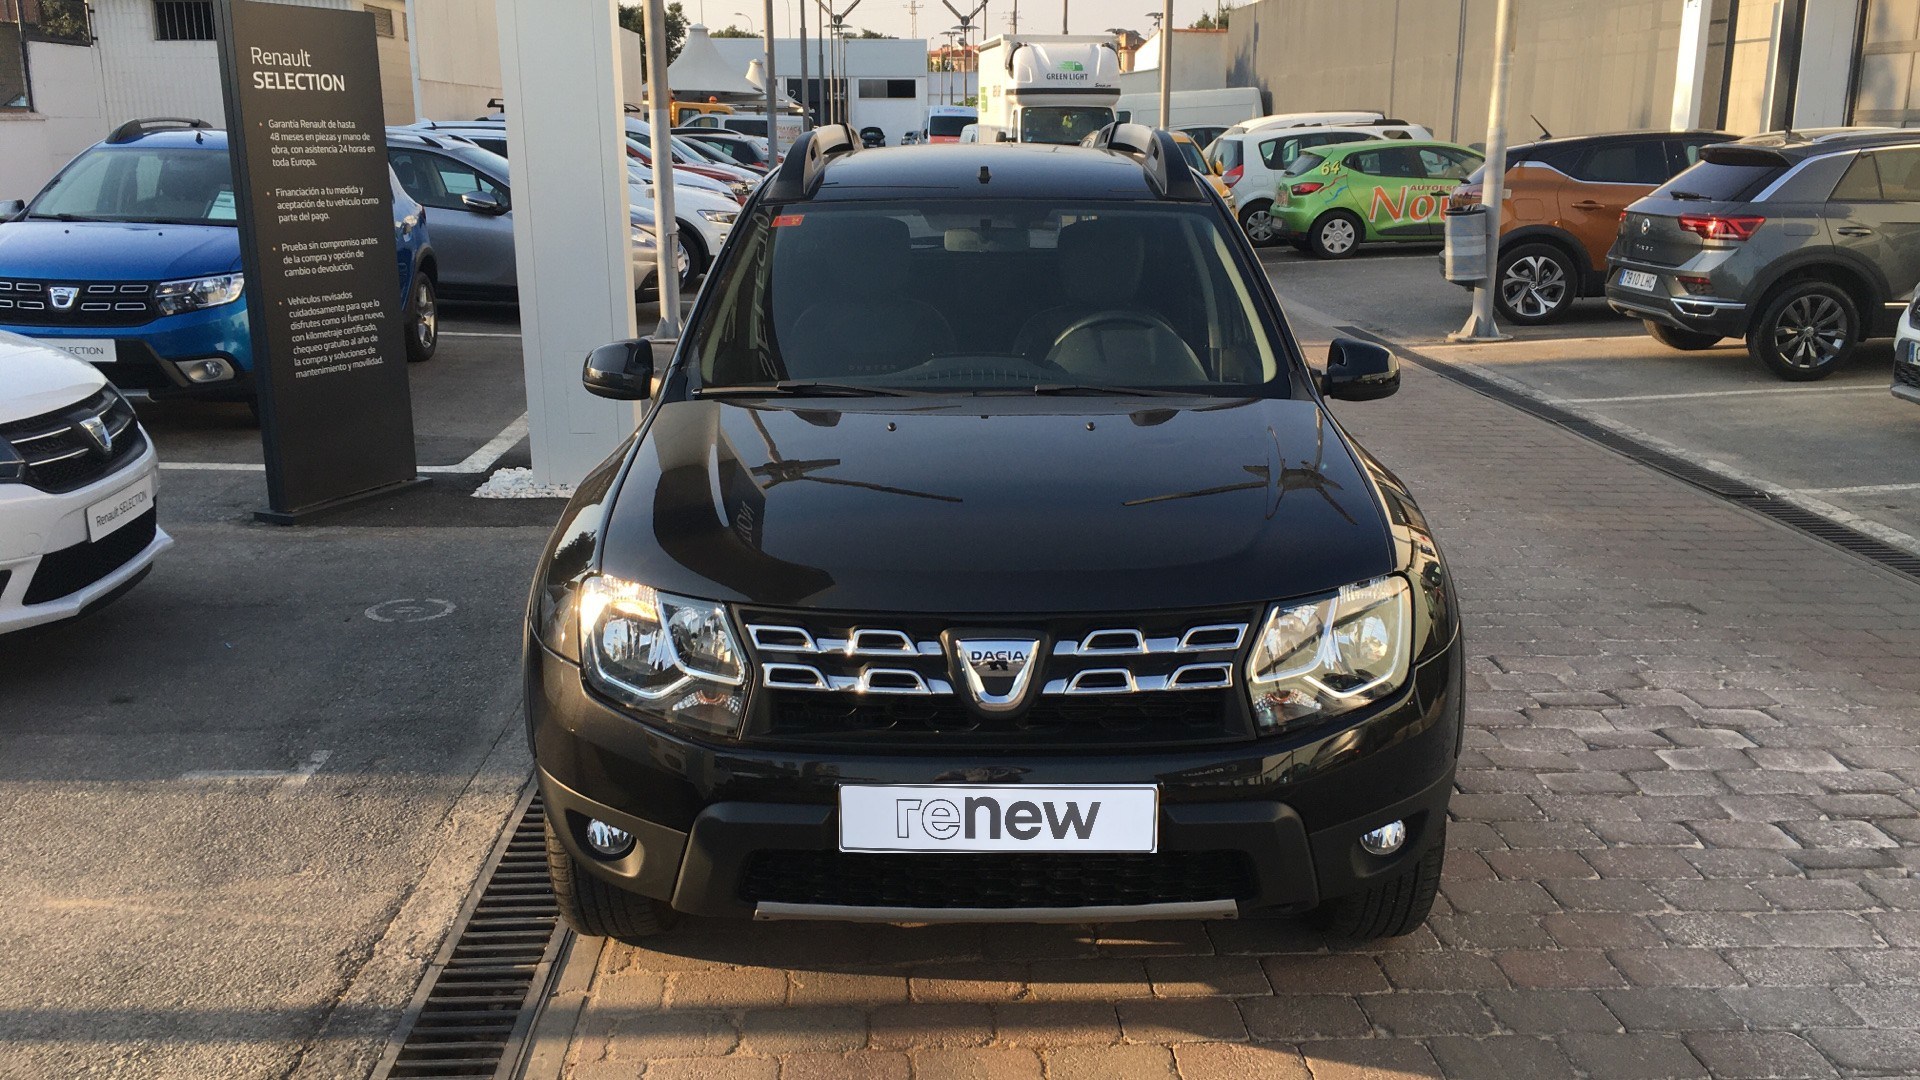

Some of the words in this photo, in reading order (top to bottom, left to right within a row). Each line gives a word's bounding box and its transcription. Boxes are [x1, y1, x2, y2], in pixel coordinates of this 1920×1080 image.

[250, 47, 311, 67] Renault
[253, 71, 345, 91] SELECTION
[300, 119, 327, 128] Renault
[328, 120, 336, 128] de
[337, 120, 356, 129] hasta
[270, 132, 279, 141] 48
[315, 133, 336, 142] piezas
[337, 134, 341, 142] y
[362, 132, 370, 140] de
[271, 145, 290, 155] obra,
[305, 145, 337, 154] asistencia
[339, 144, 347, 153] 24
[349, 144, 366, 153] horas
[272, 158, 289, 167] toda
[291, 158, 317, 168] Europa.
[1321, 160, 1341, 175] 64
[275, 187, 319, 197] Financiación
[326, 187, 334, 195] tu
[334, 185, 358, 195] medida
[359, 187, 364, 196] y
[277, 199, 316, 210] aceptación
[316, 199, 325, 207] de
[326, 199, 334, 207] tu
[278, 213, 297, 224] parte
[299, 212, 310, 221] del
[311, 213, 330, 222] pago.
[281, 241, 307, 252] Prueba
[309, 241, 319, 250] sin
[320, 238, 359, 249] compromiso
[360, 237, 378, 245] antes
[283, 256, 292, 264] de
[293, 255, 300, 264] la
[301, 254, 327, 264] compra
[328, 253, 332, 262] y
[333, 250, 355, 261] opción
[355, 249, 364, 258] de
[284, 266, 310, 277] cambio
[317, 262, 354, 274] devolución.
[322, 291, 353, 302] revisados
[289, 304, 345, 318] cuidadosamente
[346, 303, 360, 313] para
[361, 301, 373, 310] que
[373, 299, 380, 307] lo
[290, 319, 321, 331] disfrutes
[321, 317, 340, 326] como
[341, 315, 347, 323] si
[347, 314, 364, 323] fuera
[364, 311, 385, 320] nuevo,
[292, 334, 305, 342] con
[306, 328, 343, 340] kilometraje
[343, 323, 377, 335] certificado,
[59, 346, 104, 355] ECTION
[293, 343, 323, 355] chequeo
[323, 339, 350, 351] gratuito
[350, 337, 357, 346] al
[357, 336, 369, 345] año
[370, 334, 378, 342] de
[293, 358, 301, 367] la
[302, 354, 328, 366] compra
[329, 354, 333, 362] y
[334, 348, 367, 360] soluciones
[367, 346, 376, 354] de
[295, 363, 347, 379] mantenimiento
[347, 362, 352, 371] y
[96, 505, 119, 527] Renault
[119, 489, 147, 515] SELECTION
[971, 650, 1024, 661] DACIA
[896, 796, 1102, 841] renew
